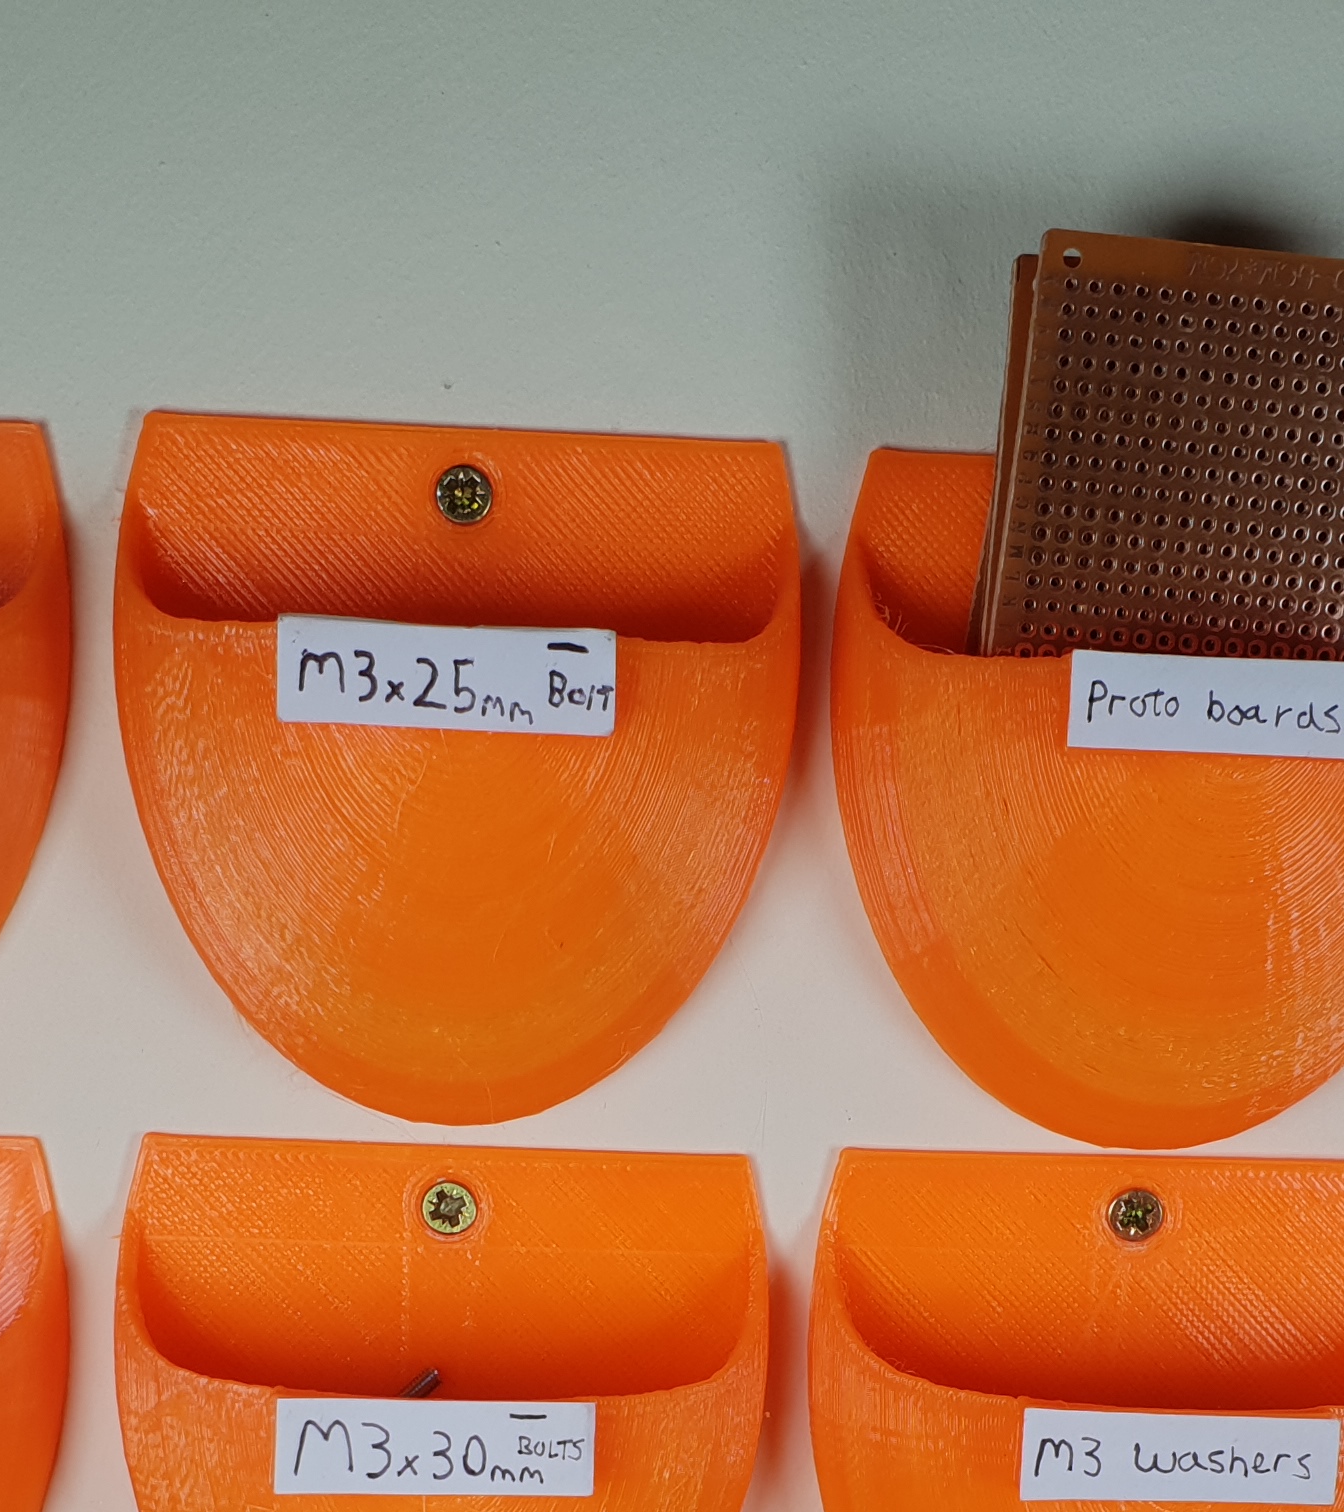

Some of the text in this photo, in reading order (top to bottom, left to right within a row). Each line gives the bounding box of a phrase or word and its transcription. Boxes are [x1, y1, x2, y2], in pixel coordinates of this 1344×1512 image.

[1086, 679, 1343, 735] Proto boards
[1033, 1436, 1312, 1480] M3 washers
